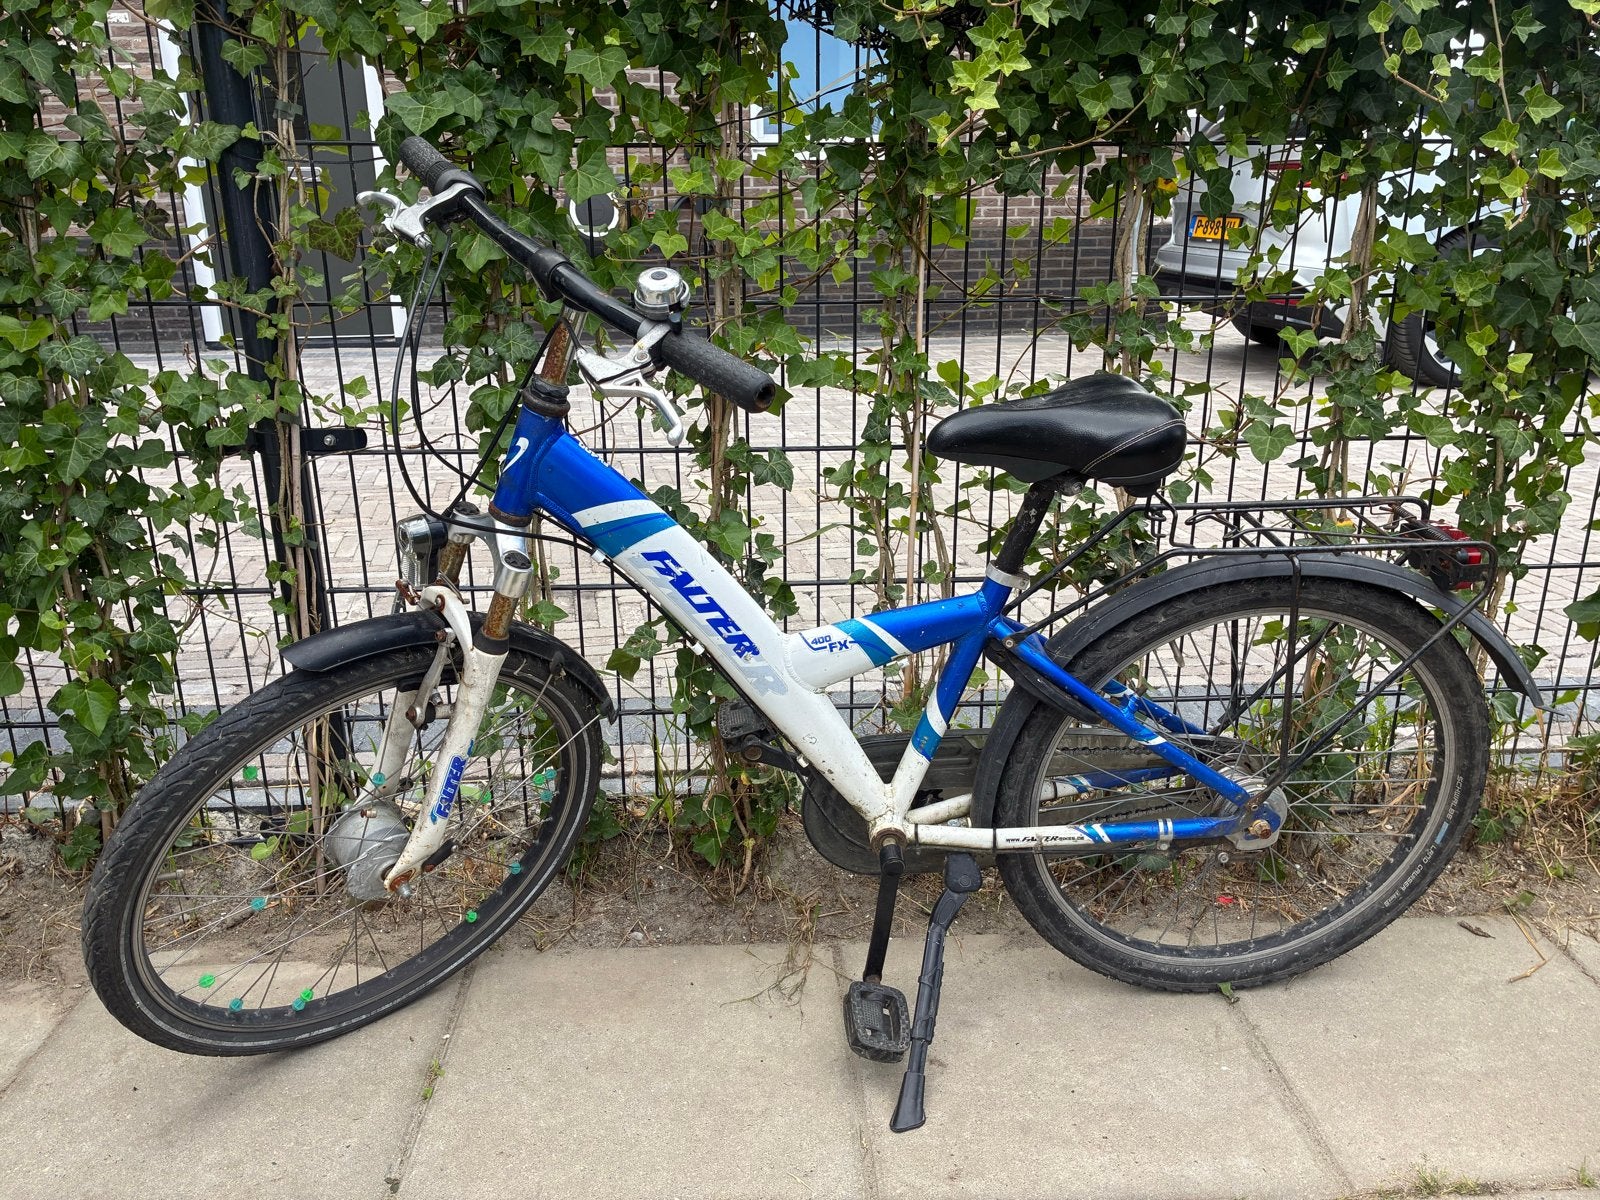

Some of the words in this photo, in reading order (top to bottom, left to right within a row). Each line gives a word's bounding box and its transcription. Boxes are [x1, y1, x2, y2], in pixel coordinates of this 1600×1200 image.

[641, 550, 760, 658] FALTER
[811, 635, 832, 645] 400
[828, 640, 849, 652] FX
[436, 756, 467, 818] FALTER
[1447, 775, 1464, 820] SCHWALBE
[1422, 844, 1437, 865] LAND
[1401, 865, 1424, 891] CRUISER
